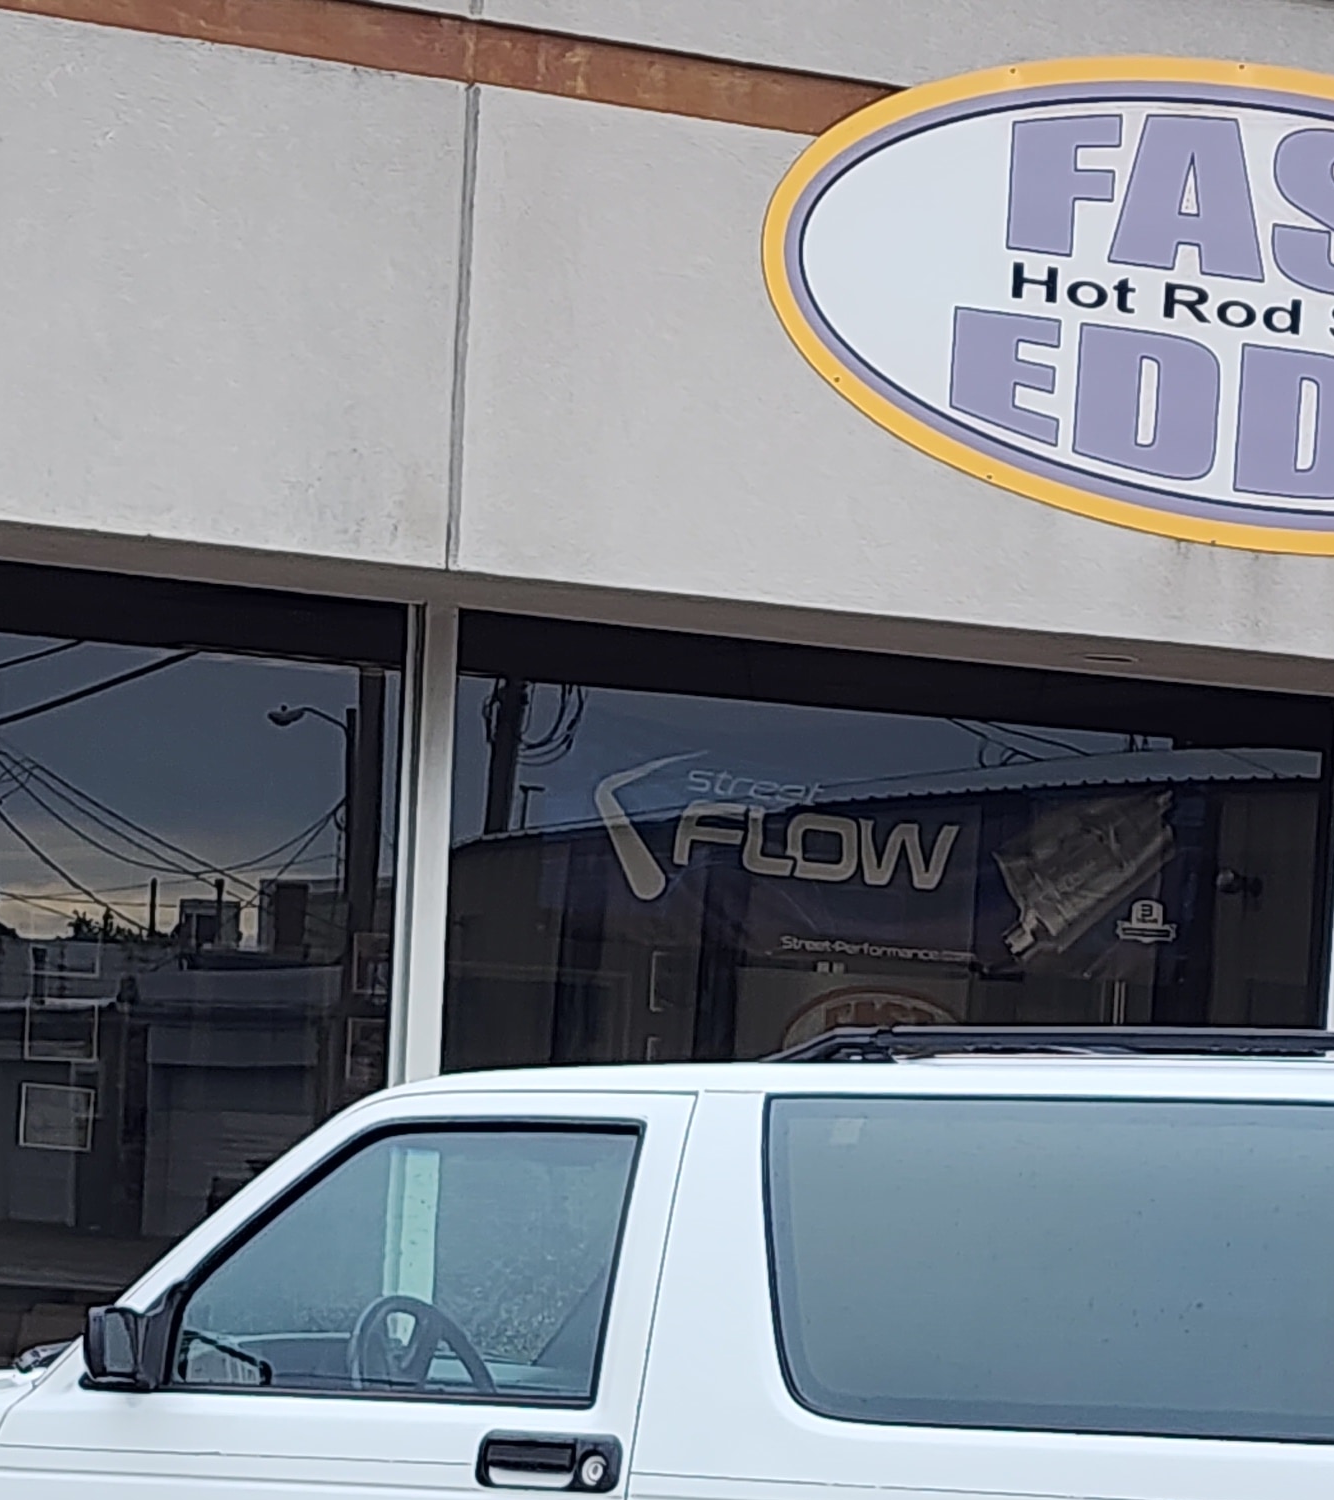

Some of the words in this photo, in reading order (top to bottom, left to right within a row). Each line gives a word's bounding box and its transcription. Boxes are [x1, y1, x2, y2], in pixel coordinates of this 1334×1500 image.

[1009, 262, 1136, 315] Hot
[1161, 281, 1302, 337] Rod
[687, 769, 825, 806] street
[672, 800, 960, 890] FLOW
